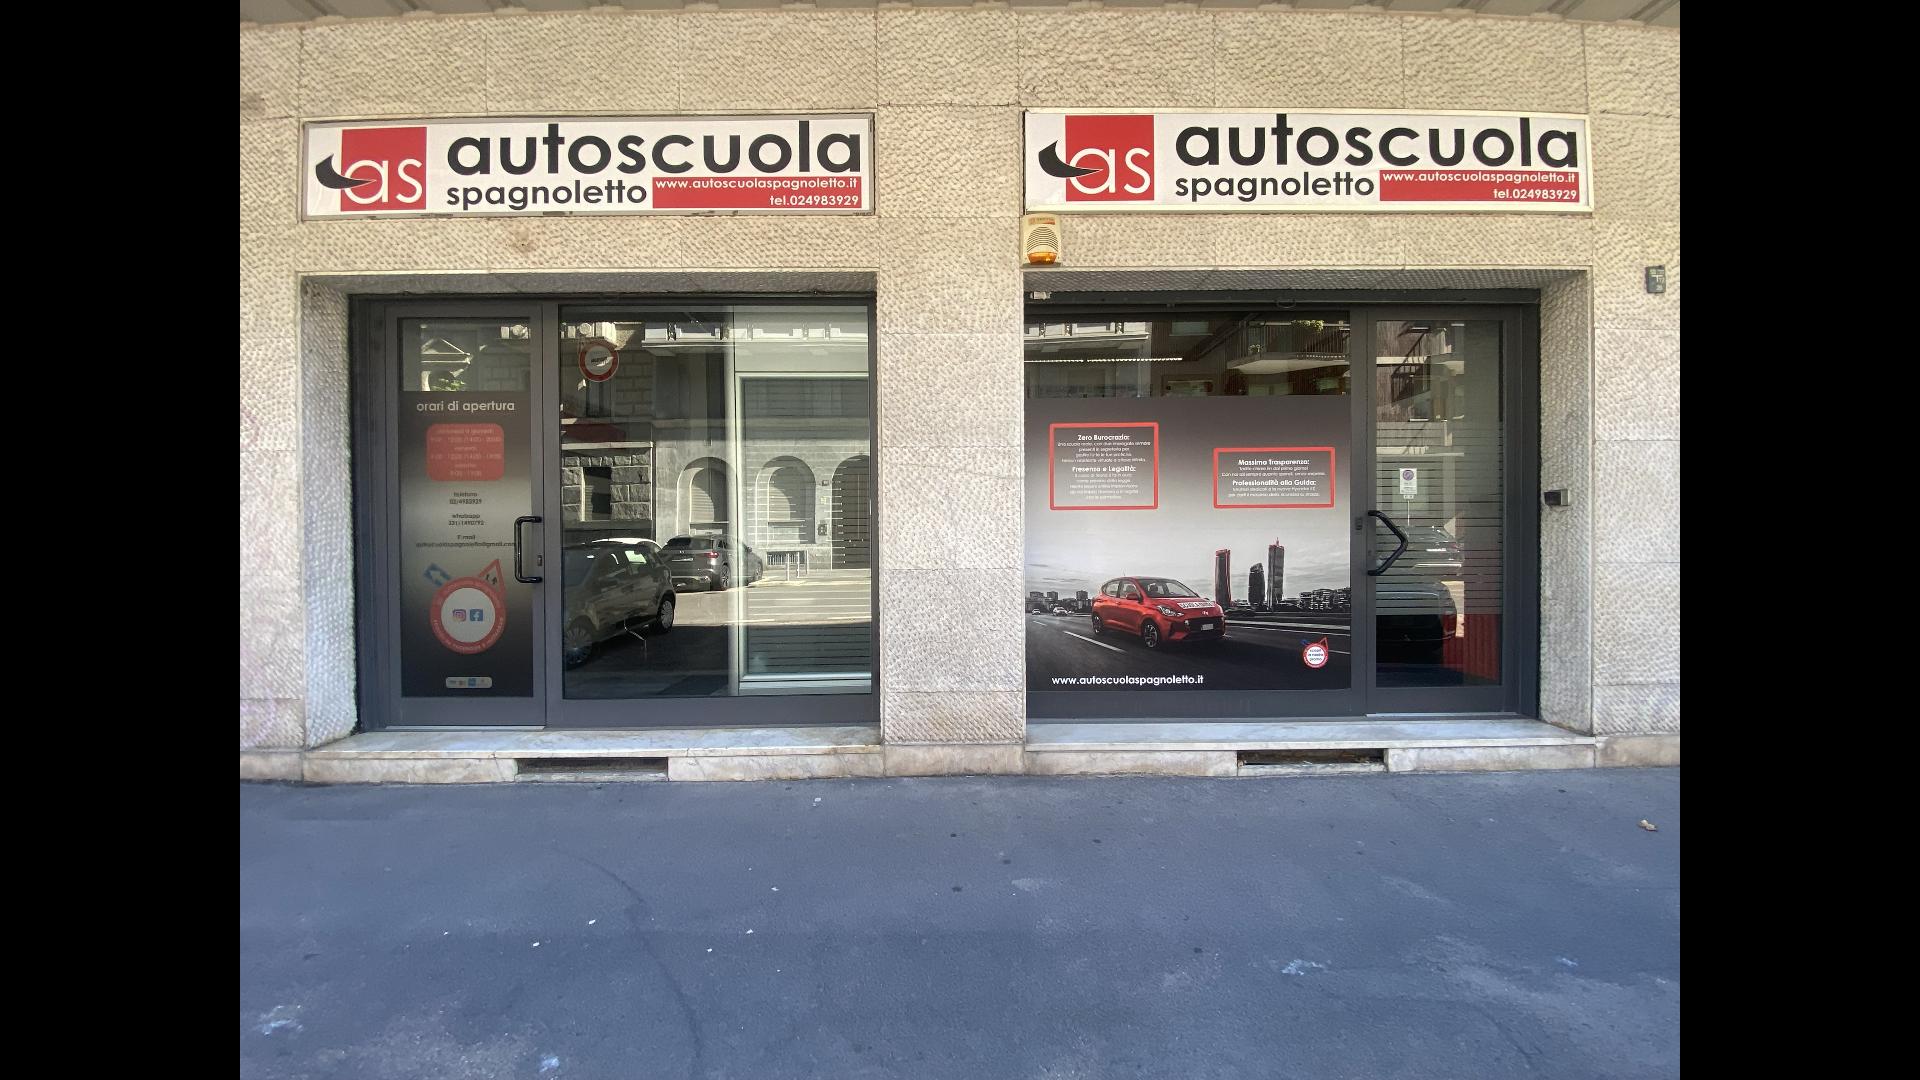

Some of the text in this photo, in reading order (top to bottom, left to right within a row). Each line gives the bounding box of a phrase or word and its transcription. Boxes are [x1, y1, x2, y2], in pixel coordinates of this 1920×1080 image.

[1175, 113, 1579, 168] autoscuola
[447, 120, 861, 175] autoscuola
[1069, 147, 1151, 194] as
[343, 158, 423, 205] as
[1382, 171, 1576, 184] www.autoscuolaspagnoletto.it
[655, 178, 857, 191] www.autoscuolaspagnoletto.it
[1175, 171, 1375, 202] spagnoletto
[446, 179, 647, 210] spagnoletto
[769, 195, 859, 206] tel.024983929
[1493, 188, 1577, 200] tel.024983929
[416, 400, 515, 413] orari di apertura
[1093, 433, 1131, 441] Burocrazia:
[1108, 465, 1137, 473] Legalità:
[1238, 458, 1310, 467] Massima Trasparenza:
[1232, 479, 1279, 487] Professionalità
[1051, 673, 1204, 687] www.autoscuolaspagnoletto.it
